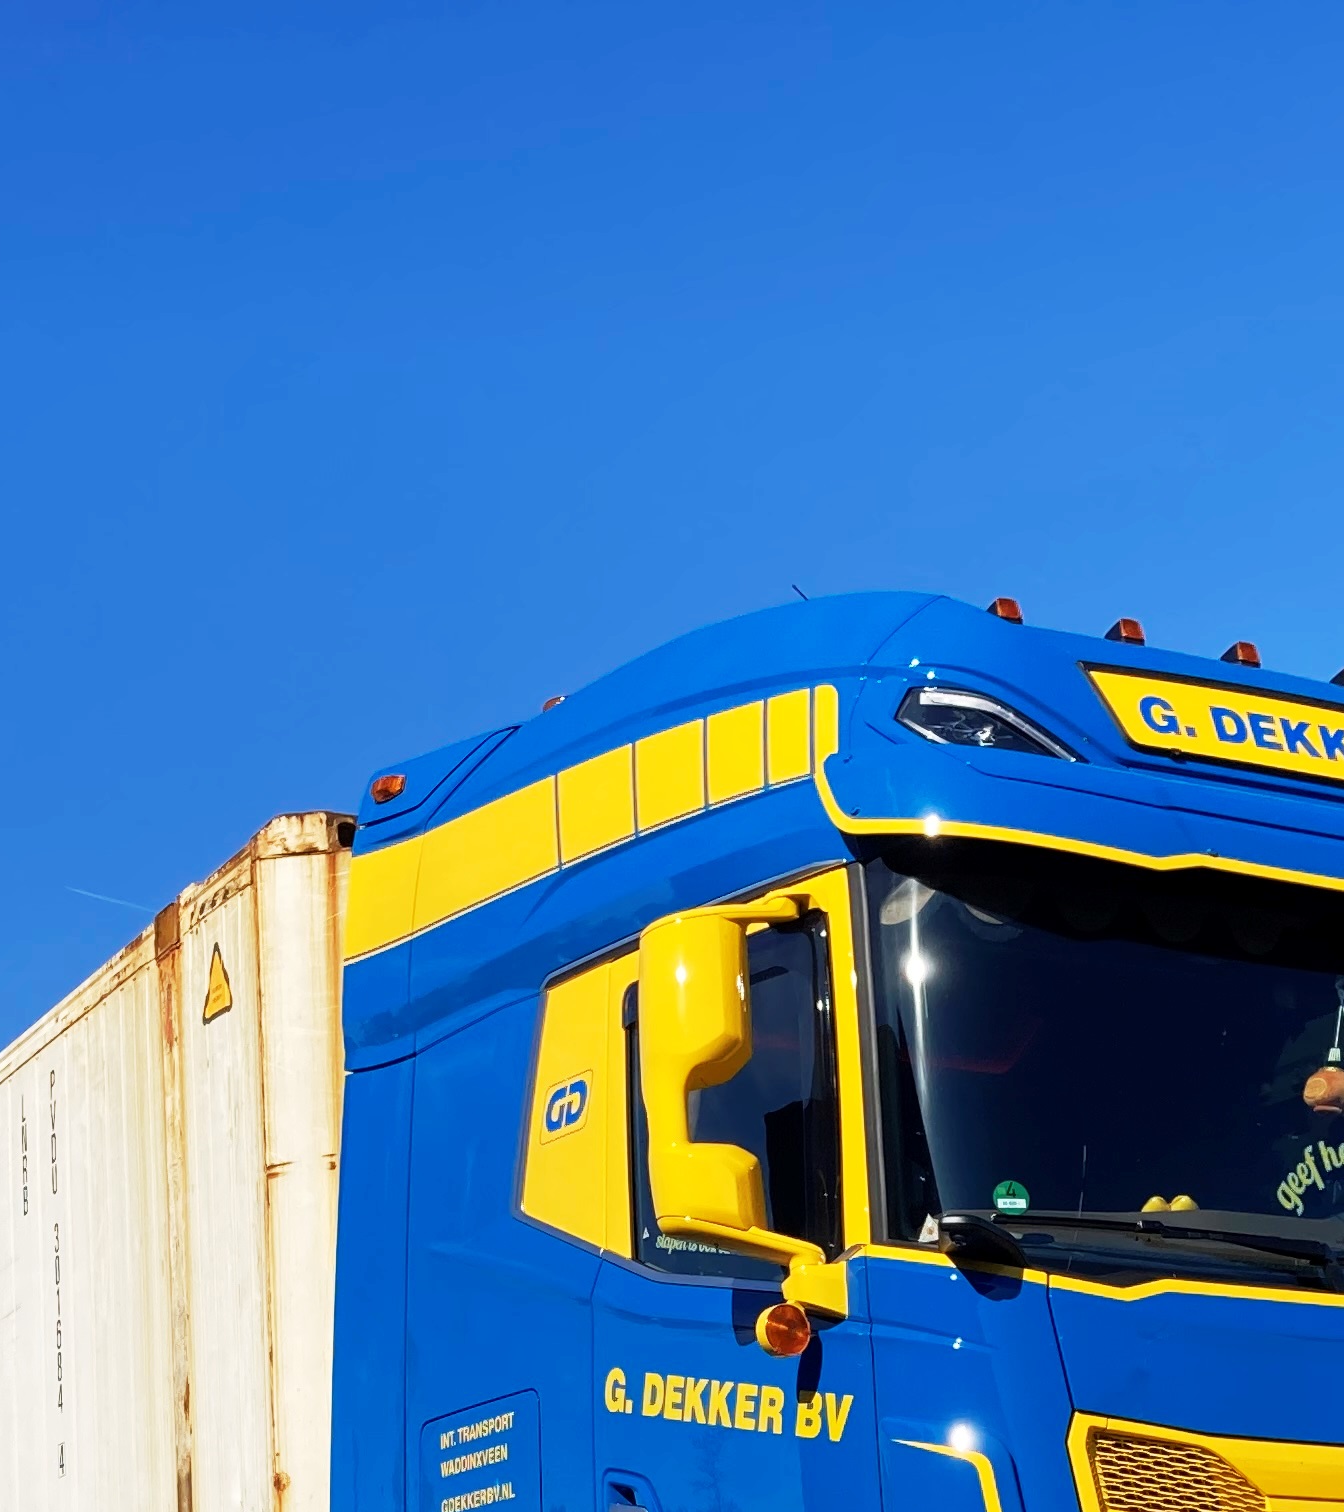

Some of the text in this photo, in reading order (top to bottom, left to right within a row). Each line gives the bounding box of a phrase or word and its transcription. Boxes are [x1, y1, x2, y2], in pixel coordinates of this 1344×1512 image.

[1139, 695, 1198, 738] G.
[1006, 1181, 1017, 1198] 4
[1276, 1144, 1326, 1218] geef
[50, 1069, 65, 1475] PVDU 301684 4
[604, 1367, 855, 1442] G. DEKKER BV
[440, 1411, 516, 1451] INT. TRANSPORT
[440, 1442, 508, 1479] WADDINXVEEN
